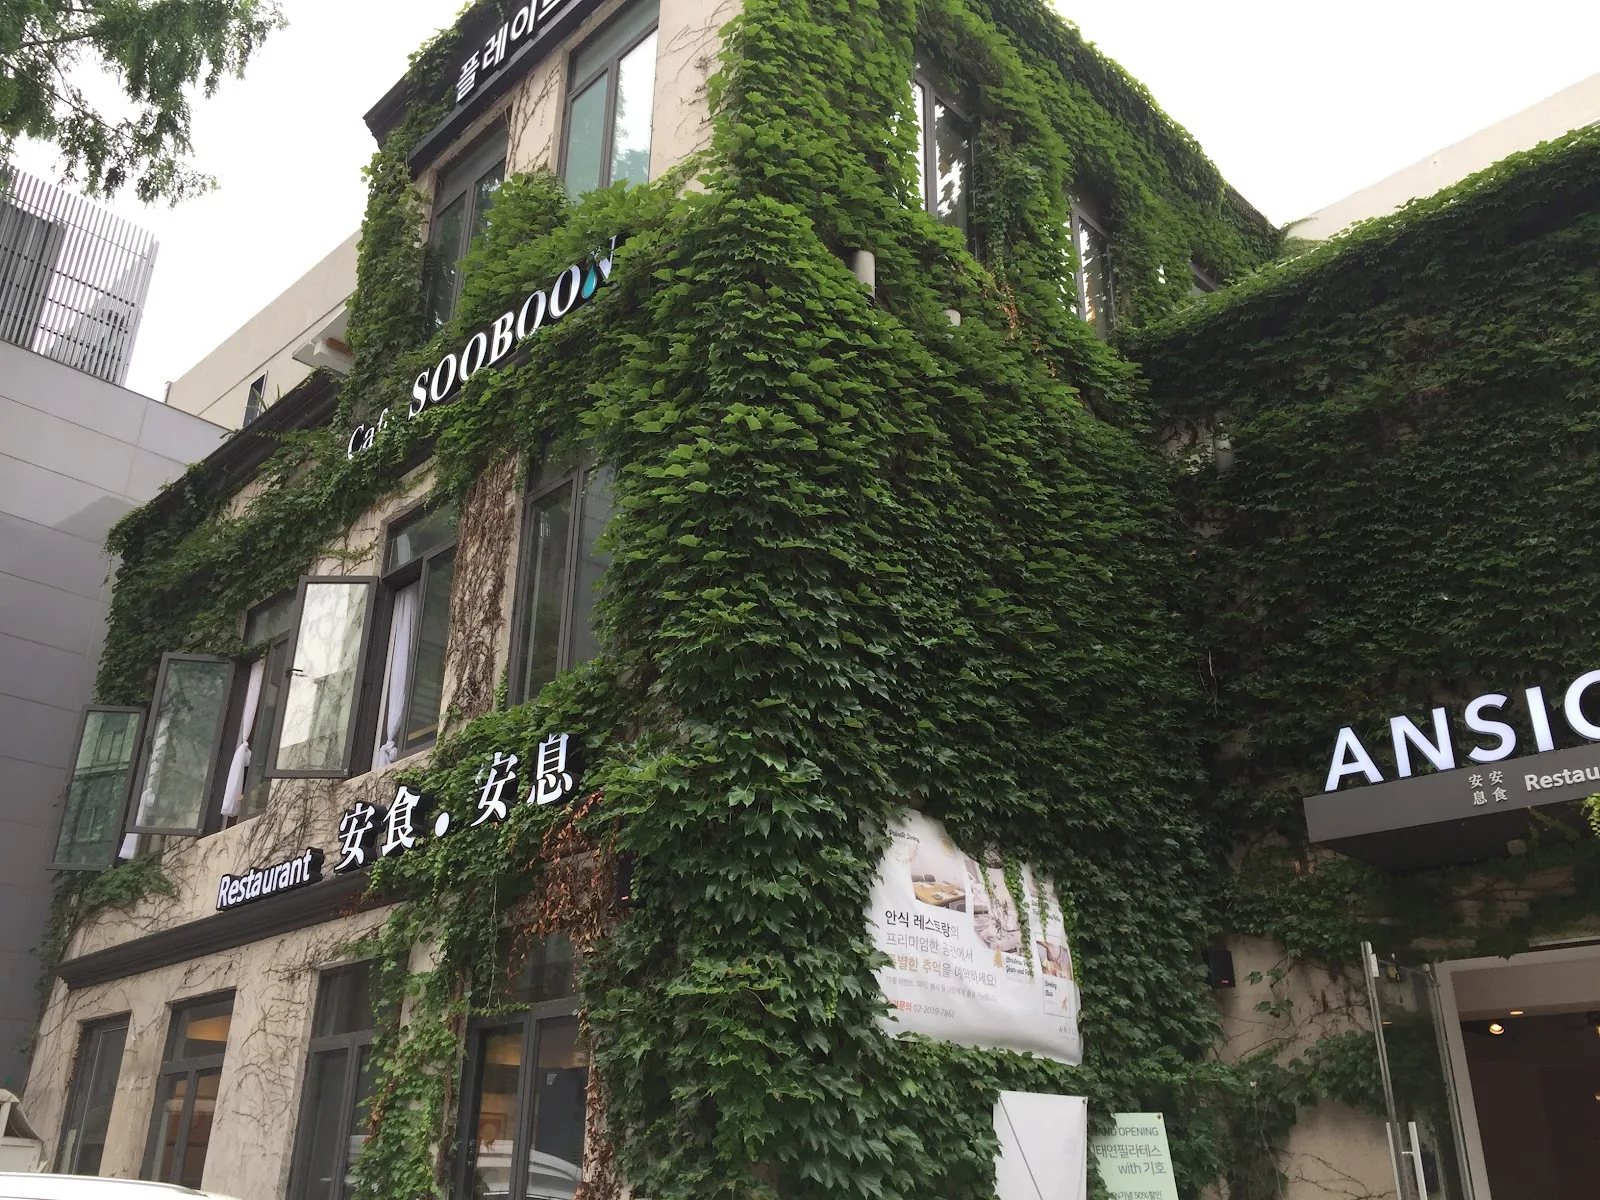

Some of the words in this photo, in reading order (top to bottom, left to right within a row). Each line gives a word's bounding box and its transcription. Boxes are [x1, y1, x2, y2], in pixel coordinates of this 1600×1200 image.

[348, 407, 395, 460] Caf
[216, 850, 312, 909] Restaurant
[885, 910, 909, 928] 안식
[913, 914, 959, 940] 레스토랑의
[886, 932, 939, 954] 프리미엄한
[942, 941, 973, 962] 공간에서
[922, 959, 951, 978] 추억을
[1096, 1127, 1117, 1137] AND
[1118, 1127, 1159, 1137] OPENING
[1118, 1162, 1141, 1174] with
[1143, 1161, 1166, 1175] 기호
